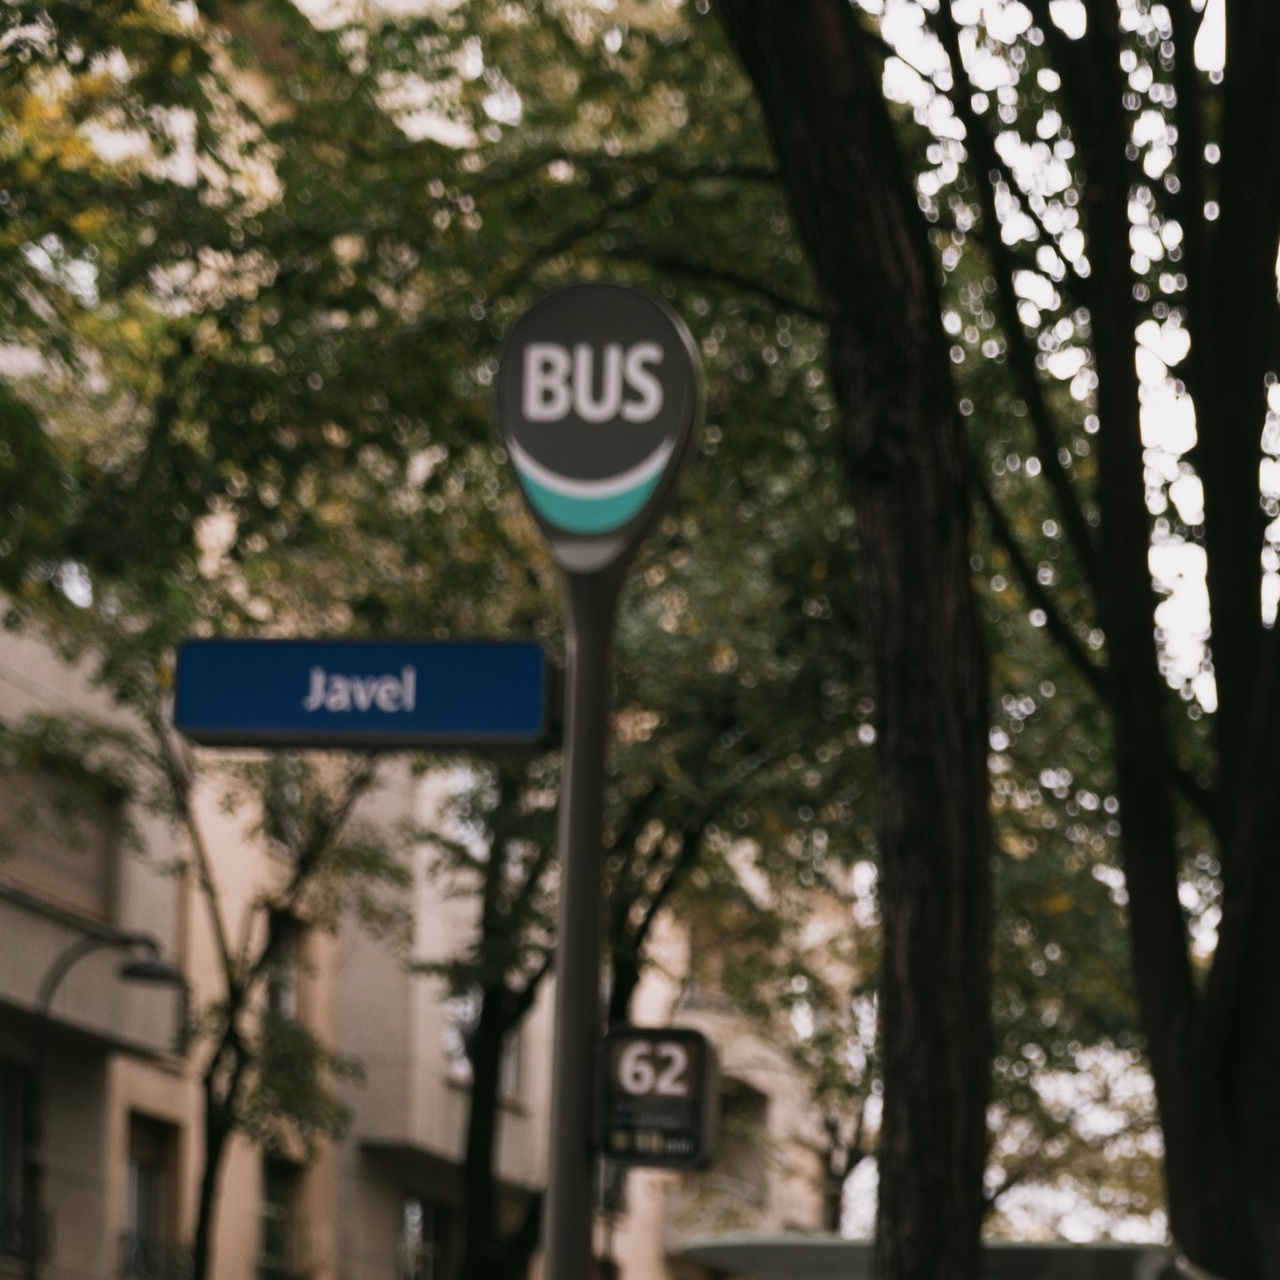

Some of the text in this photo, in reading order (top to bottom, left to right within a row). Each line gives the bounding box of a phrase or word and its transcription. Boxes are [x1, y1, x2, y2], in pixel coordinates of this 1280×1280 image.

[522, 342, 664, 423] BUS
[303, 664, 417, 712] Javel
[619, 1040, 689, 1096] 62
